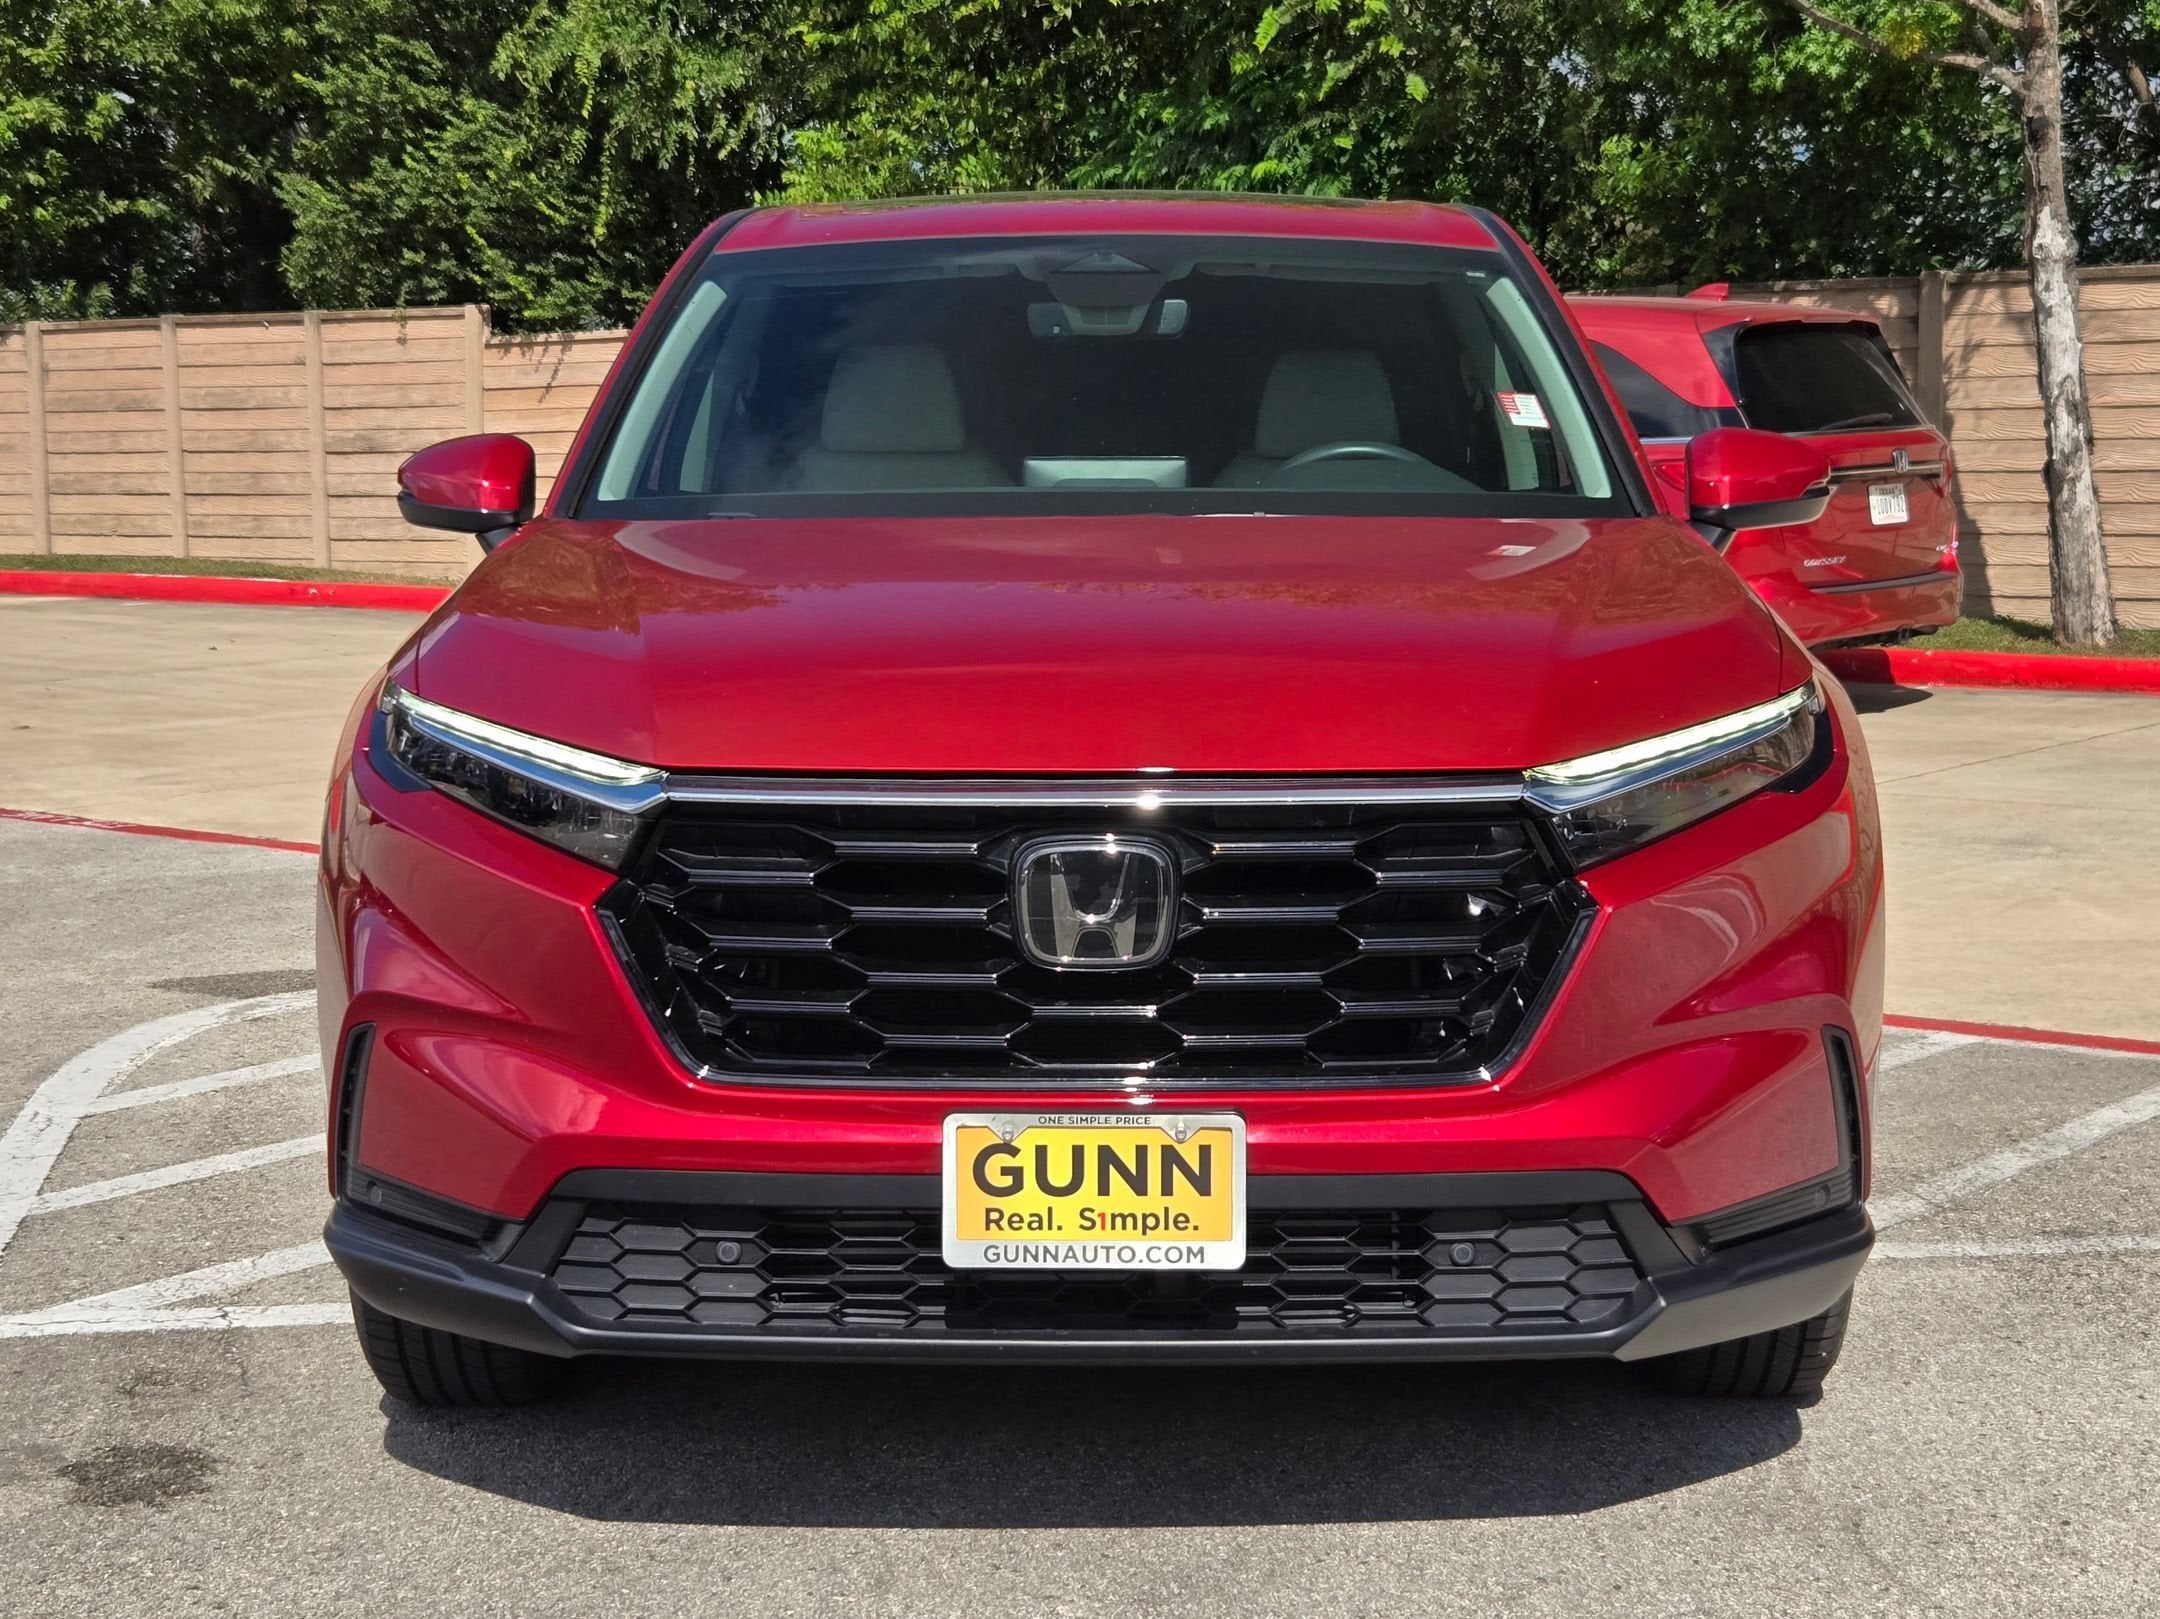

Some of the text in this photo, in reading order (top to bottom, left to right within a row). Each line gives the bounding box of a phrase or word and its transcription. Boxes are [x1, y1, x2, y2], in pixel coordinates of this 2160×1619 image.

[1038, 1116, 1151, 1125] ONE SIMPLE PRICE
[972, 1142, 1212, 1198] GUNN
[984, 1206, 1063, 1232] Real.
[983, 1244, 1205, 1264] GUNNAUTO.COM
